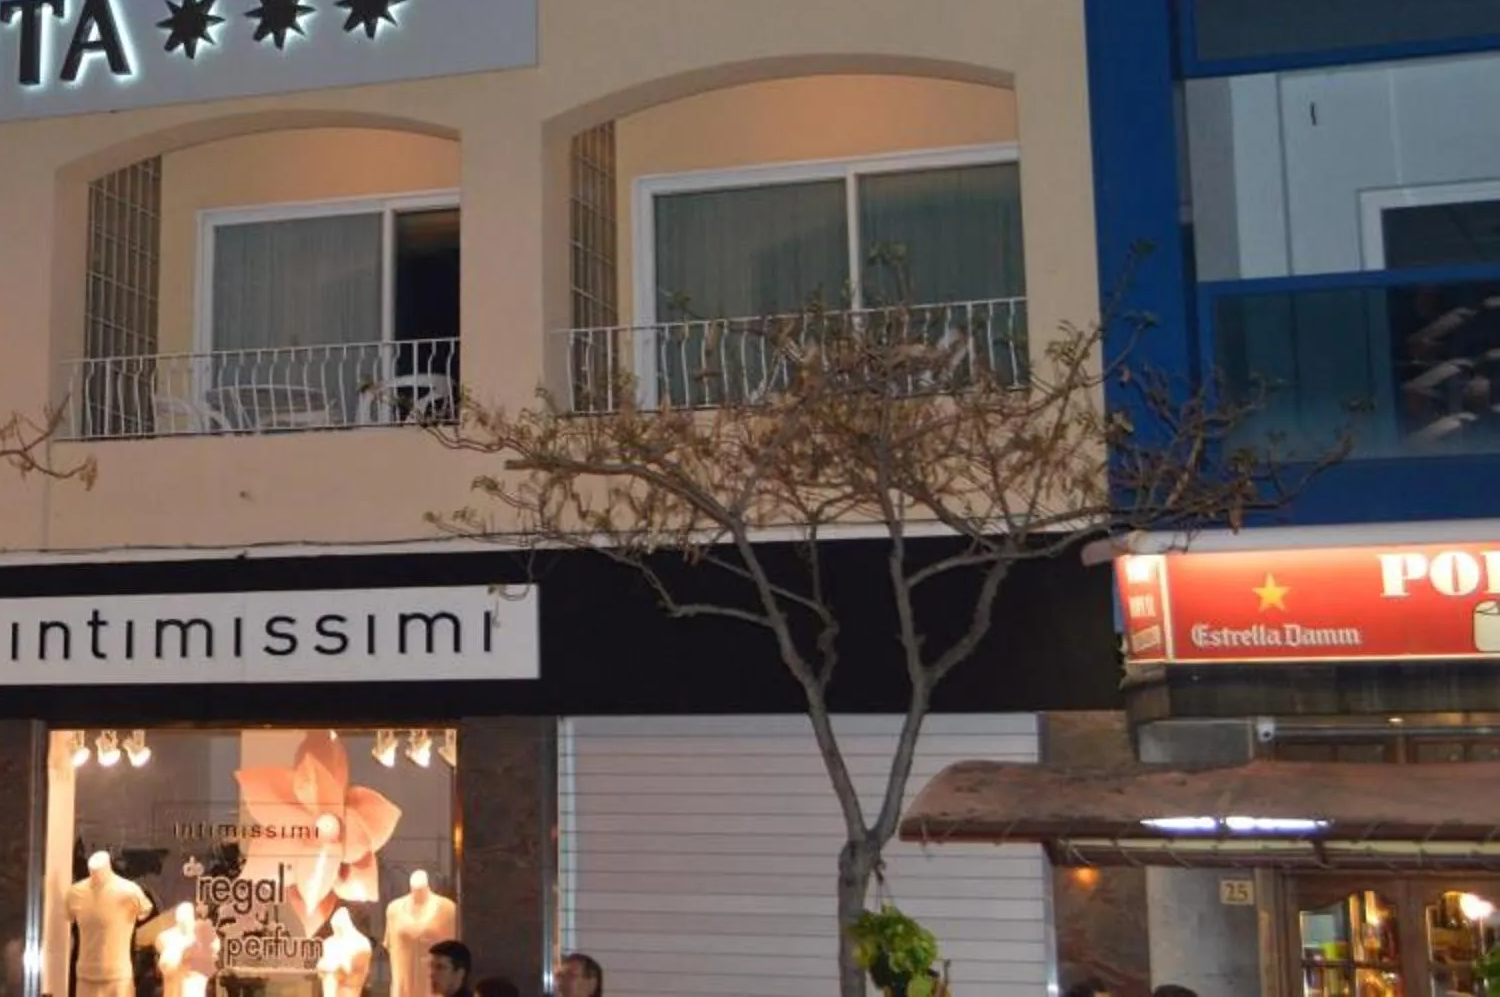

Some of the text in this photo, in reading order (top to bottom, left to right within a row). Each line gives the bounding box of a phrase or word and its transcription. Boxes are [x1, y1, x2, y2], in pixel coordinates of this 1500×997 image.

[10, 609, 493, 661] intimissimi
[1191, 621, 1361, 648] Estrella Damm
[173, 819, 319, 840] intimissimi
[197, 862, 285, 914] regal
[1223, 882, 1249, 902] 25
[226, 926, 323, 966] perfum
